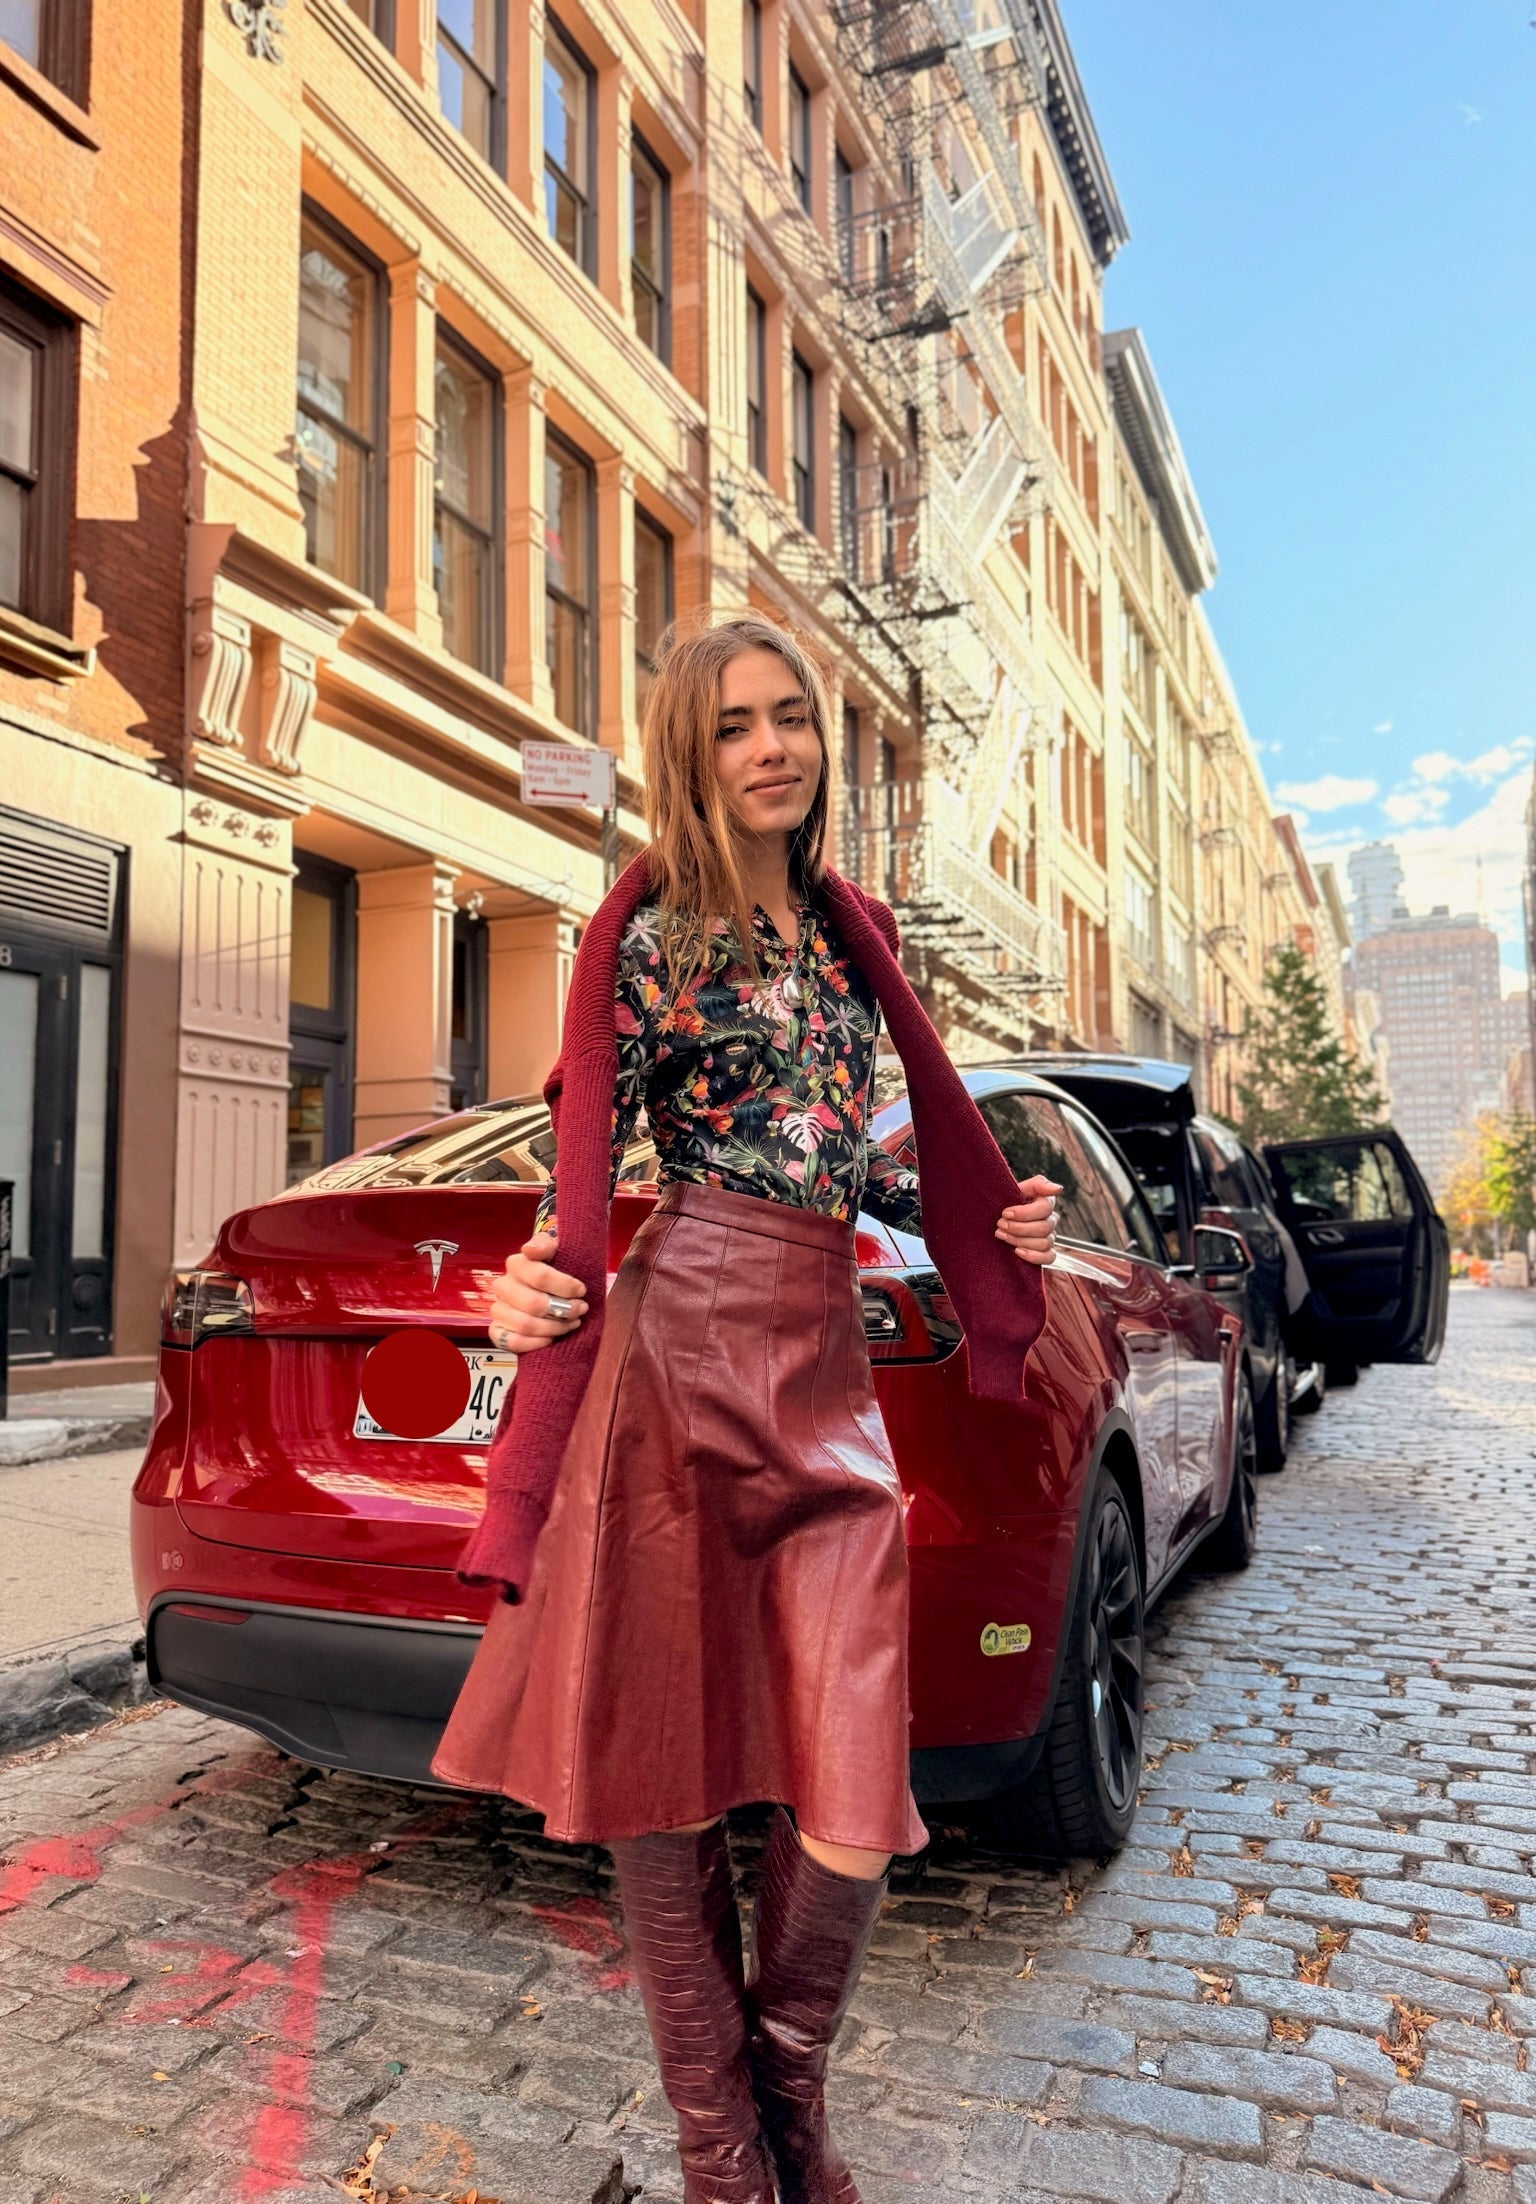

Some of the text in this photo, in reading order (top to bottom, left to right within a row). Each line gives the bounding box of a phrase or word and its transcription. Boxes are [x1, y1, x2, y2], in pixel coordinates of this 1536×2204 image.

[527, 750, 591, 764] NO PARKING
[527, 764, 558, 775] Monday
[566, 765, 591, 777] Friday
